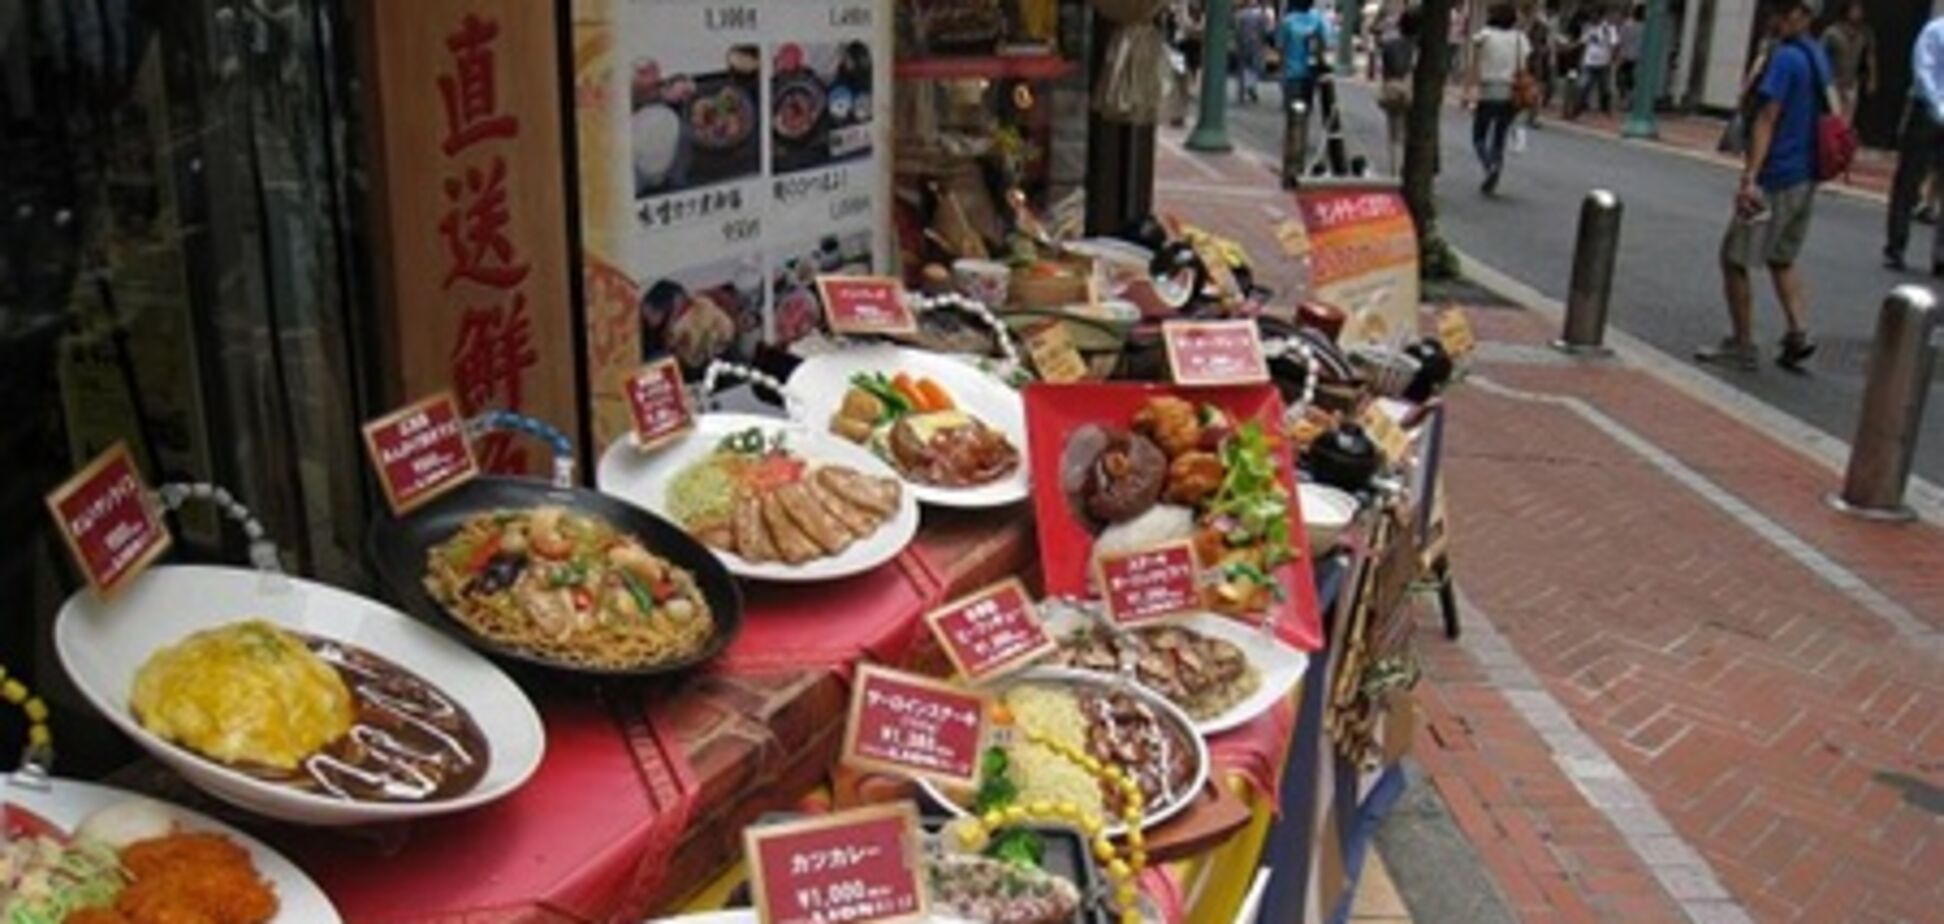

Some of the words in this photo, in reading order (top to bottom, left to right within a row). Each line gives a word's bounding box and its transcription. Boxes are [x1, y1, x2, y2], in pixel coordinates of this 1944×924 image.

[867, 689, 977, 729] サーロインステーキ
[791, 845, 881, 876] カツカレー
[797, 879, 865, 909] ¥1,000
